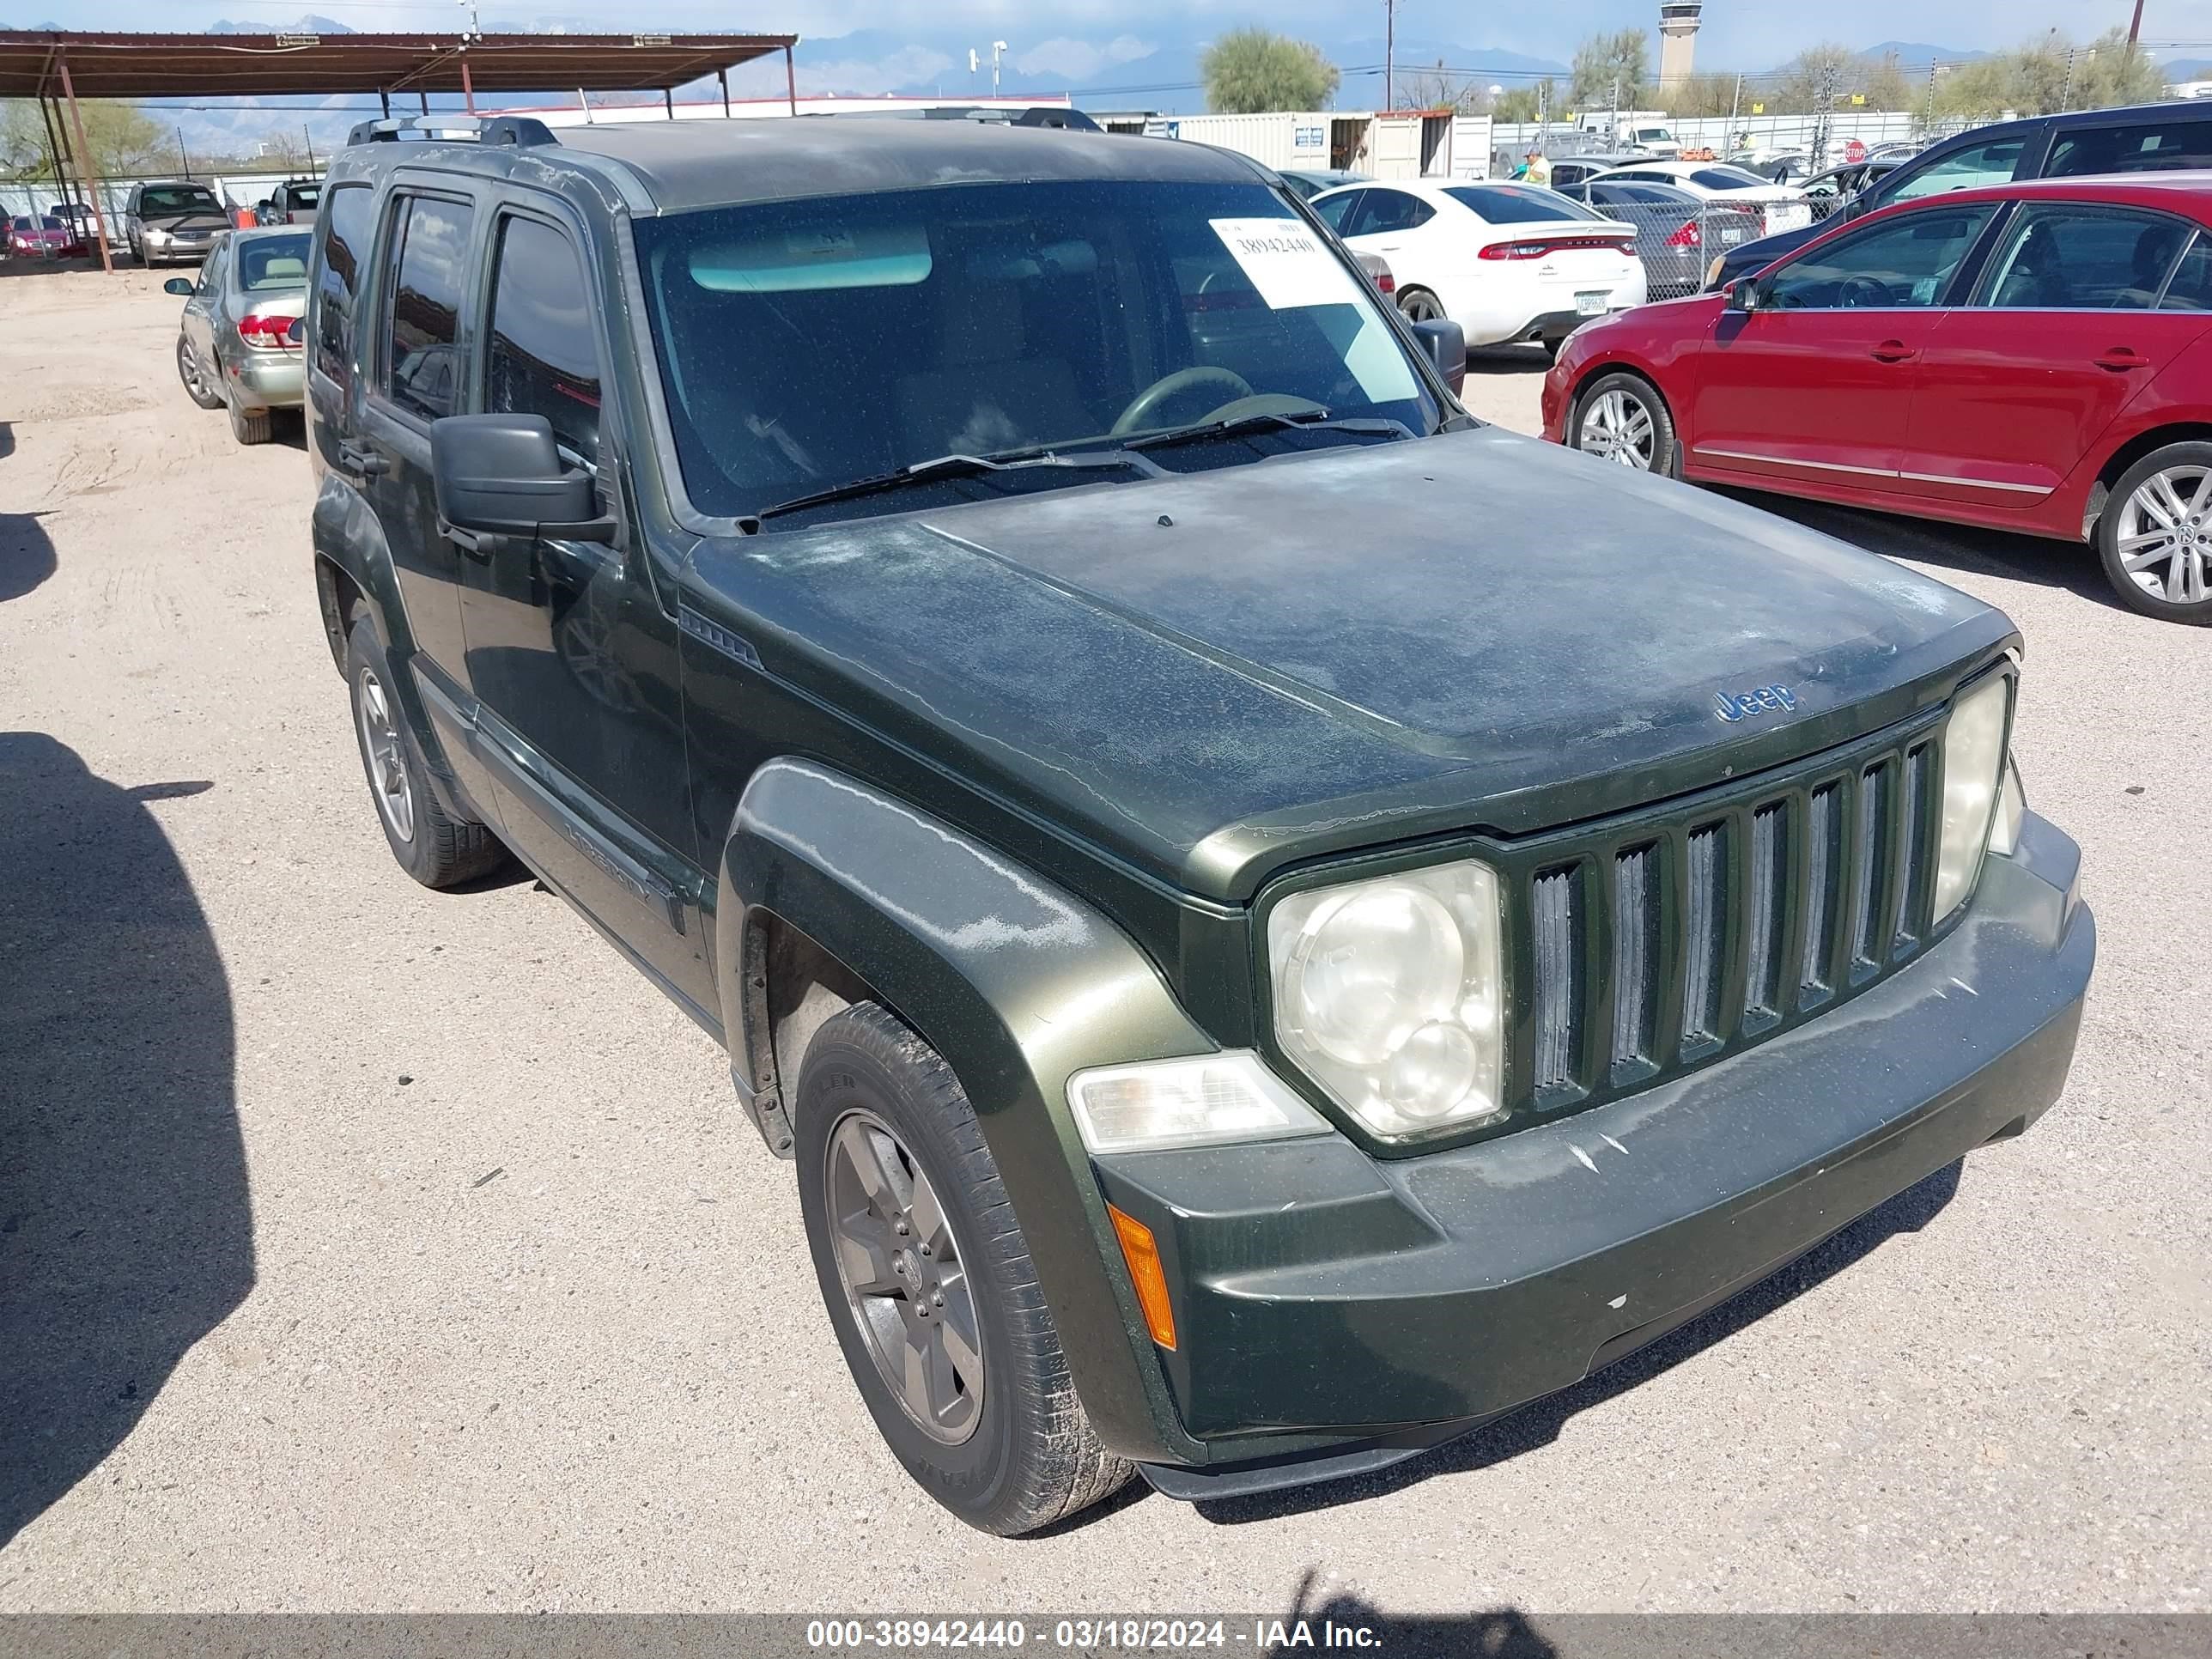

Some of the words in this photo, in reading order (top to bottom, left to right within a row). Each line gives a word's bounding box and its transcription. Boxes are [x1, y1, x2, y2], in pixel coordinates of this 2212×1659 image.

[1846, 148, 1865, 159] STOP
[1237, 238, 1316, 255] 38942440
[1712, 684, 1796, 723] Jeep
